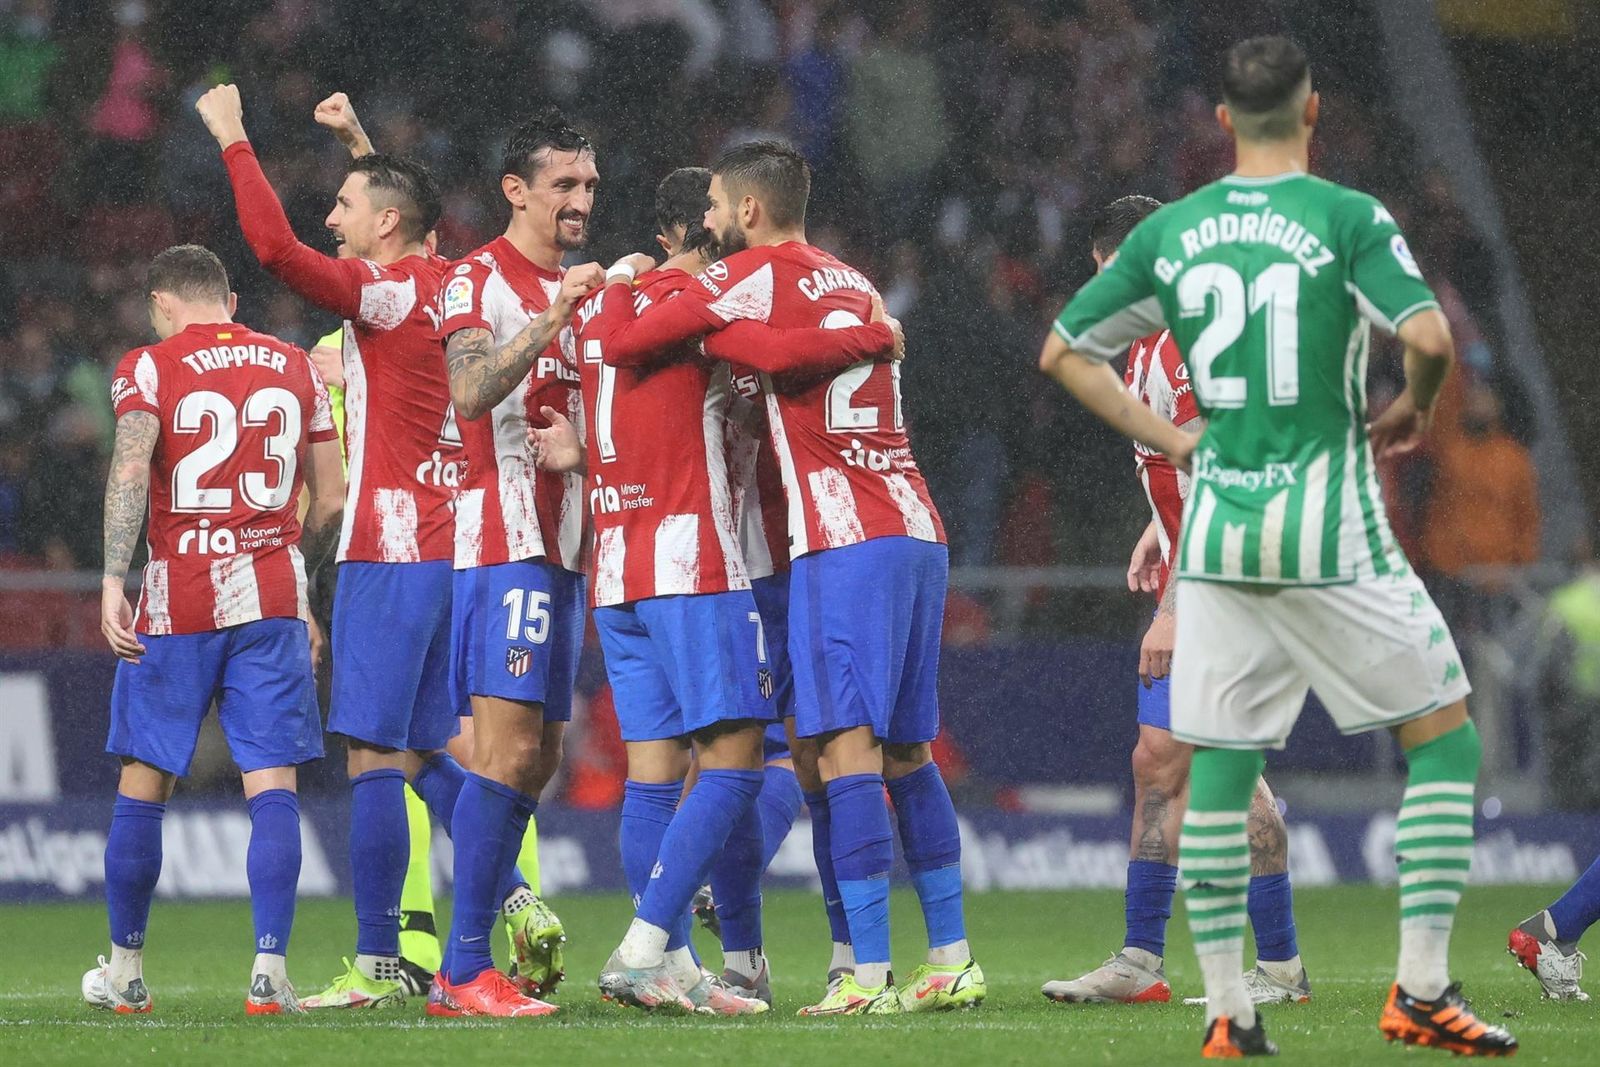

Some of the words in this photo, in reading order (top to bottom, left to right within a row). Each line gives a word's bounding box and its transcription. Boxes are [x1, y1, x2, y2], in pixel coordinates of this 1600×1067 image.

[1154, 256, 1183, 285] G.
[1180, 206, 1335, 278] RODRÍGUEZ
[1177, 262, 1300, 408] 21
[182, 344, 287, 375] TRIPPIER
[171, 387, 301, 513] 23
[416, 451, 459, 487] ria
[840, 439, 891, 472] ria
[590, 474, 620, 515] ria
[178, 518, 236, 554] ria
[240, 526, 281, 539] Money
[502, 588, 551, 644] 15
[748, 612, 767, 664] 7
